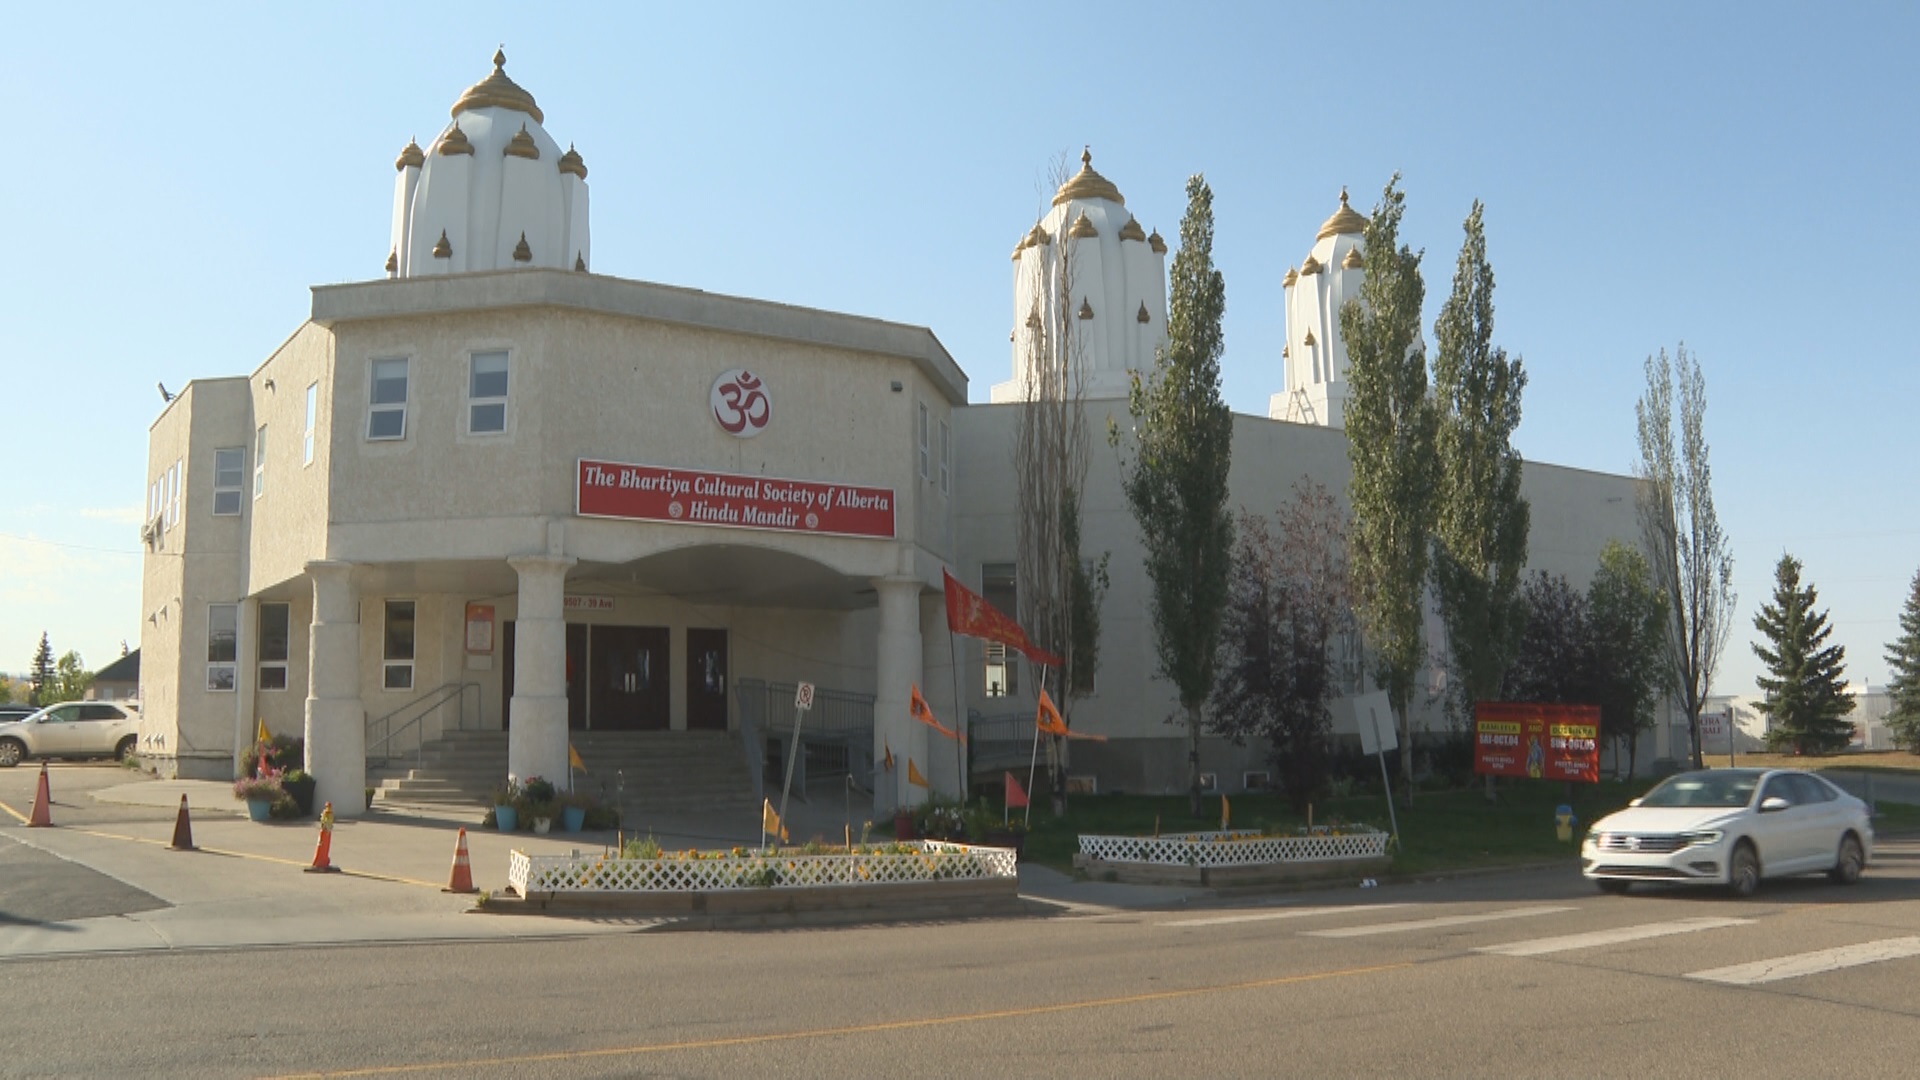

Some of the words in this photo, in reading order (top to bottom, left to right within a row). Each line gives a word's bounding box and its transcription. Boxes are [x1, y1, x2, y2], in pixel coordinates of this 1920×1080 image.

[585, 466, 615, 487] The
[619, 469, 690, 498] Bhartiya
[694, 477, 759, 499] Cultural
[763, 483, 815, 509] Society
[818, 487, 835, 511] of
[836, 489, 889, 511] Alberta
[689, 499, 738, 522] Hindu
[742, 505, 799, 527] Mandir
